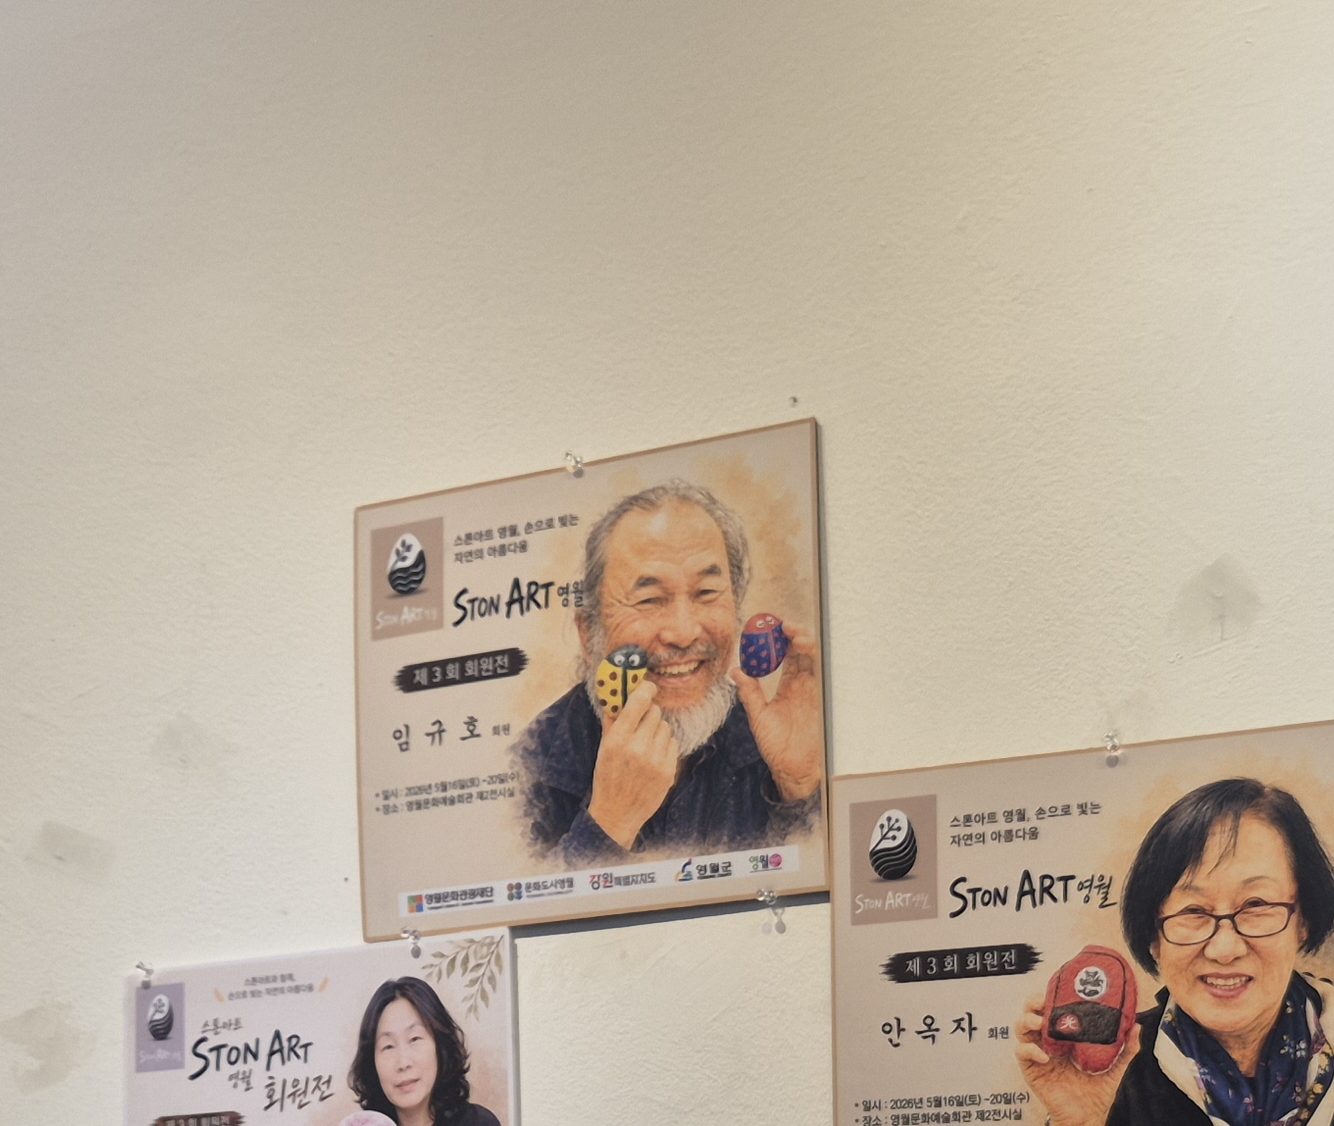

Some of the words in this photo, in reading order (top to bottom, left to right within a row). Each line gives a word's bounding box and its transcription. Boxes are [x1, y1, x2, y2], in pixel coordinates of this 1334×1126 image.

[452, 588, 500, 627] STON
[465, 654, 509, 678] 회원전
[949, 811, 998, 828] 스톤아트
[1003, 809, 1030, 823] 영월,
[1035, 805, 1071, 820] 손으로
[950, 832, 985, 847] 자연의
[991, 826, 1039, 843] 아름다움
[949, 877, 1008, 918] STON
[965, 949, 1017, 971] 회원전
[988, 1026, 1009, 1039] 회원
[188, 1036, 260, 1080] STON
[266, 1029, 314, 1071] ART
[264, 1075, 334, 1112] 회원전
[890, 1098, 923, 1110] 2026년
[890, 1111, 971, 1125] 영월문화예술회관
[975, 1109, 1022, 1121] 제2전시실
